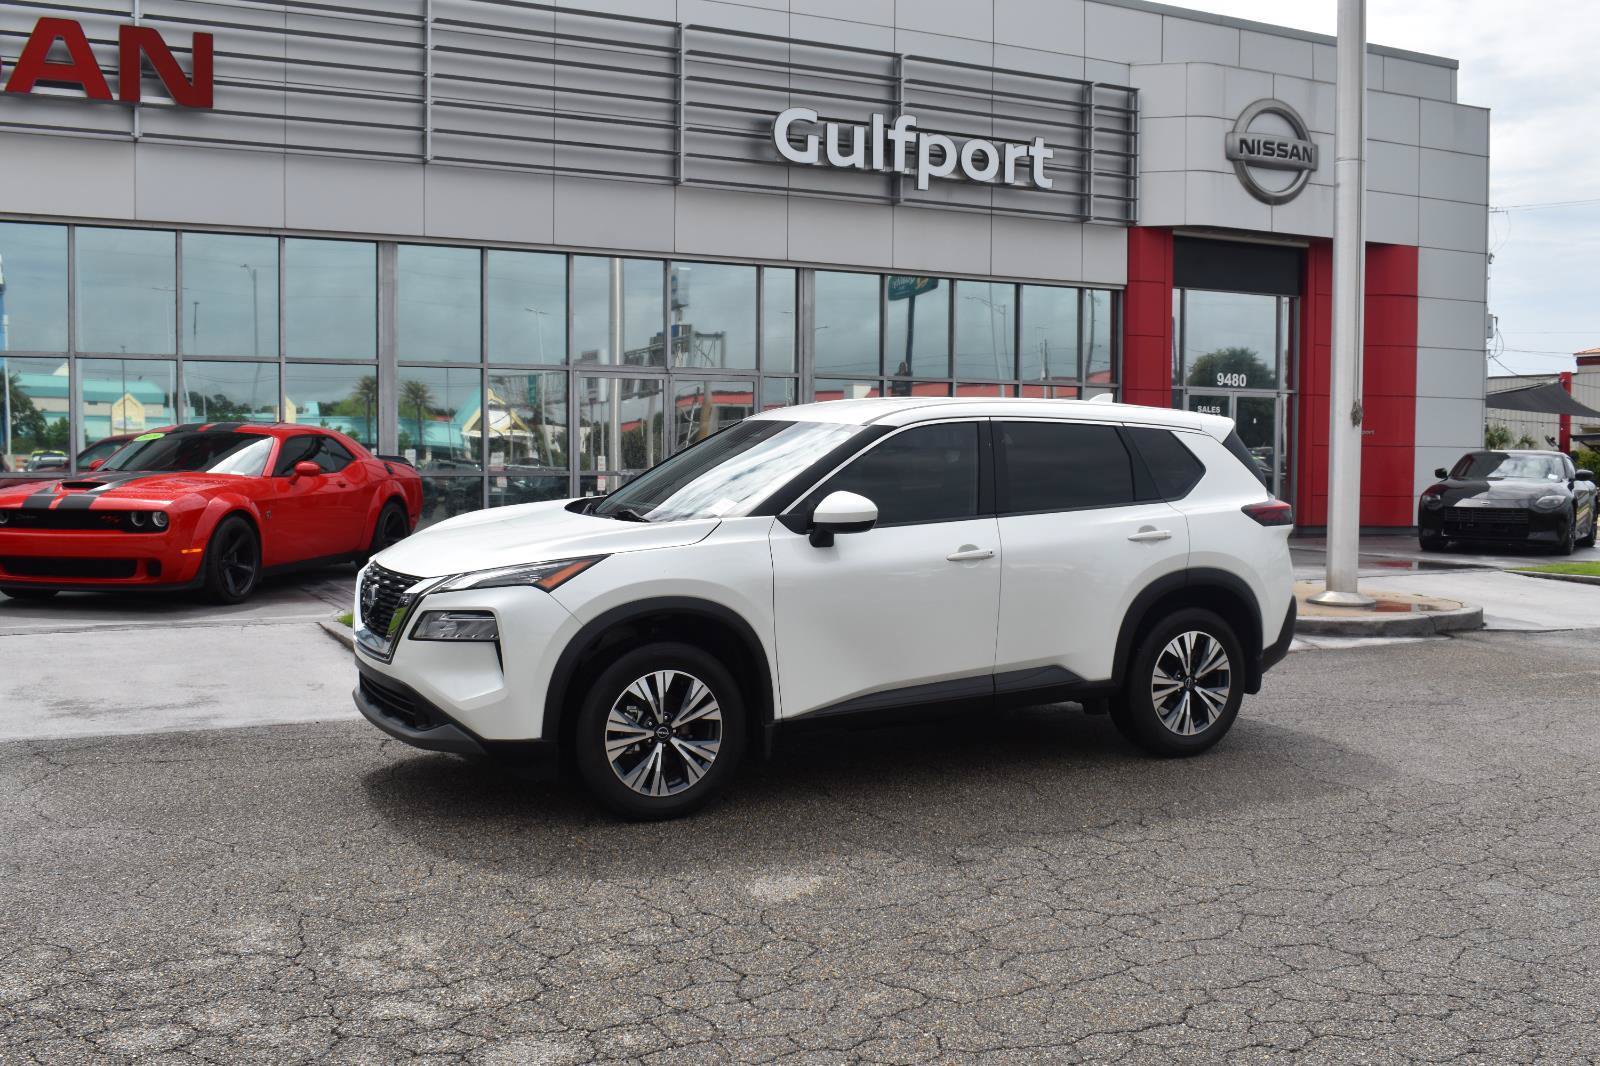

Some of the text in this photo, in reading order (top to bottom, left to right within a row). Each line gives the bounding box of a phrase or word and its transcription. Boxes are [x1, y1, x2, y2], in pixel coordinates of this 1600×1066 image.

[5, 17, 213, 109] AN
[773, 107, 1054, 190] Gulfport
[1239, 138, 1312, 163] NISSAN
[1216, 372, 1247, 387] 9480
[1197, 405, 1221, 414] SALES
